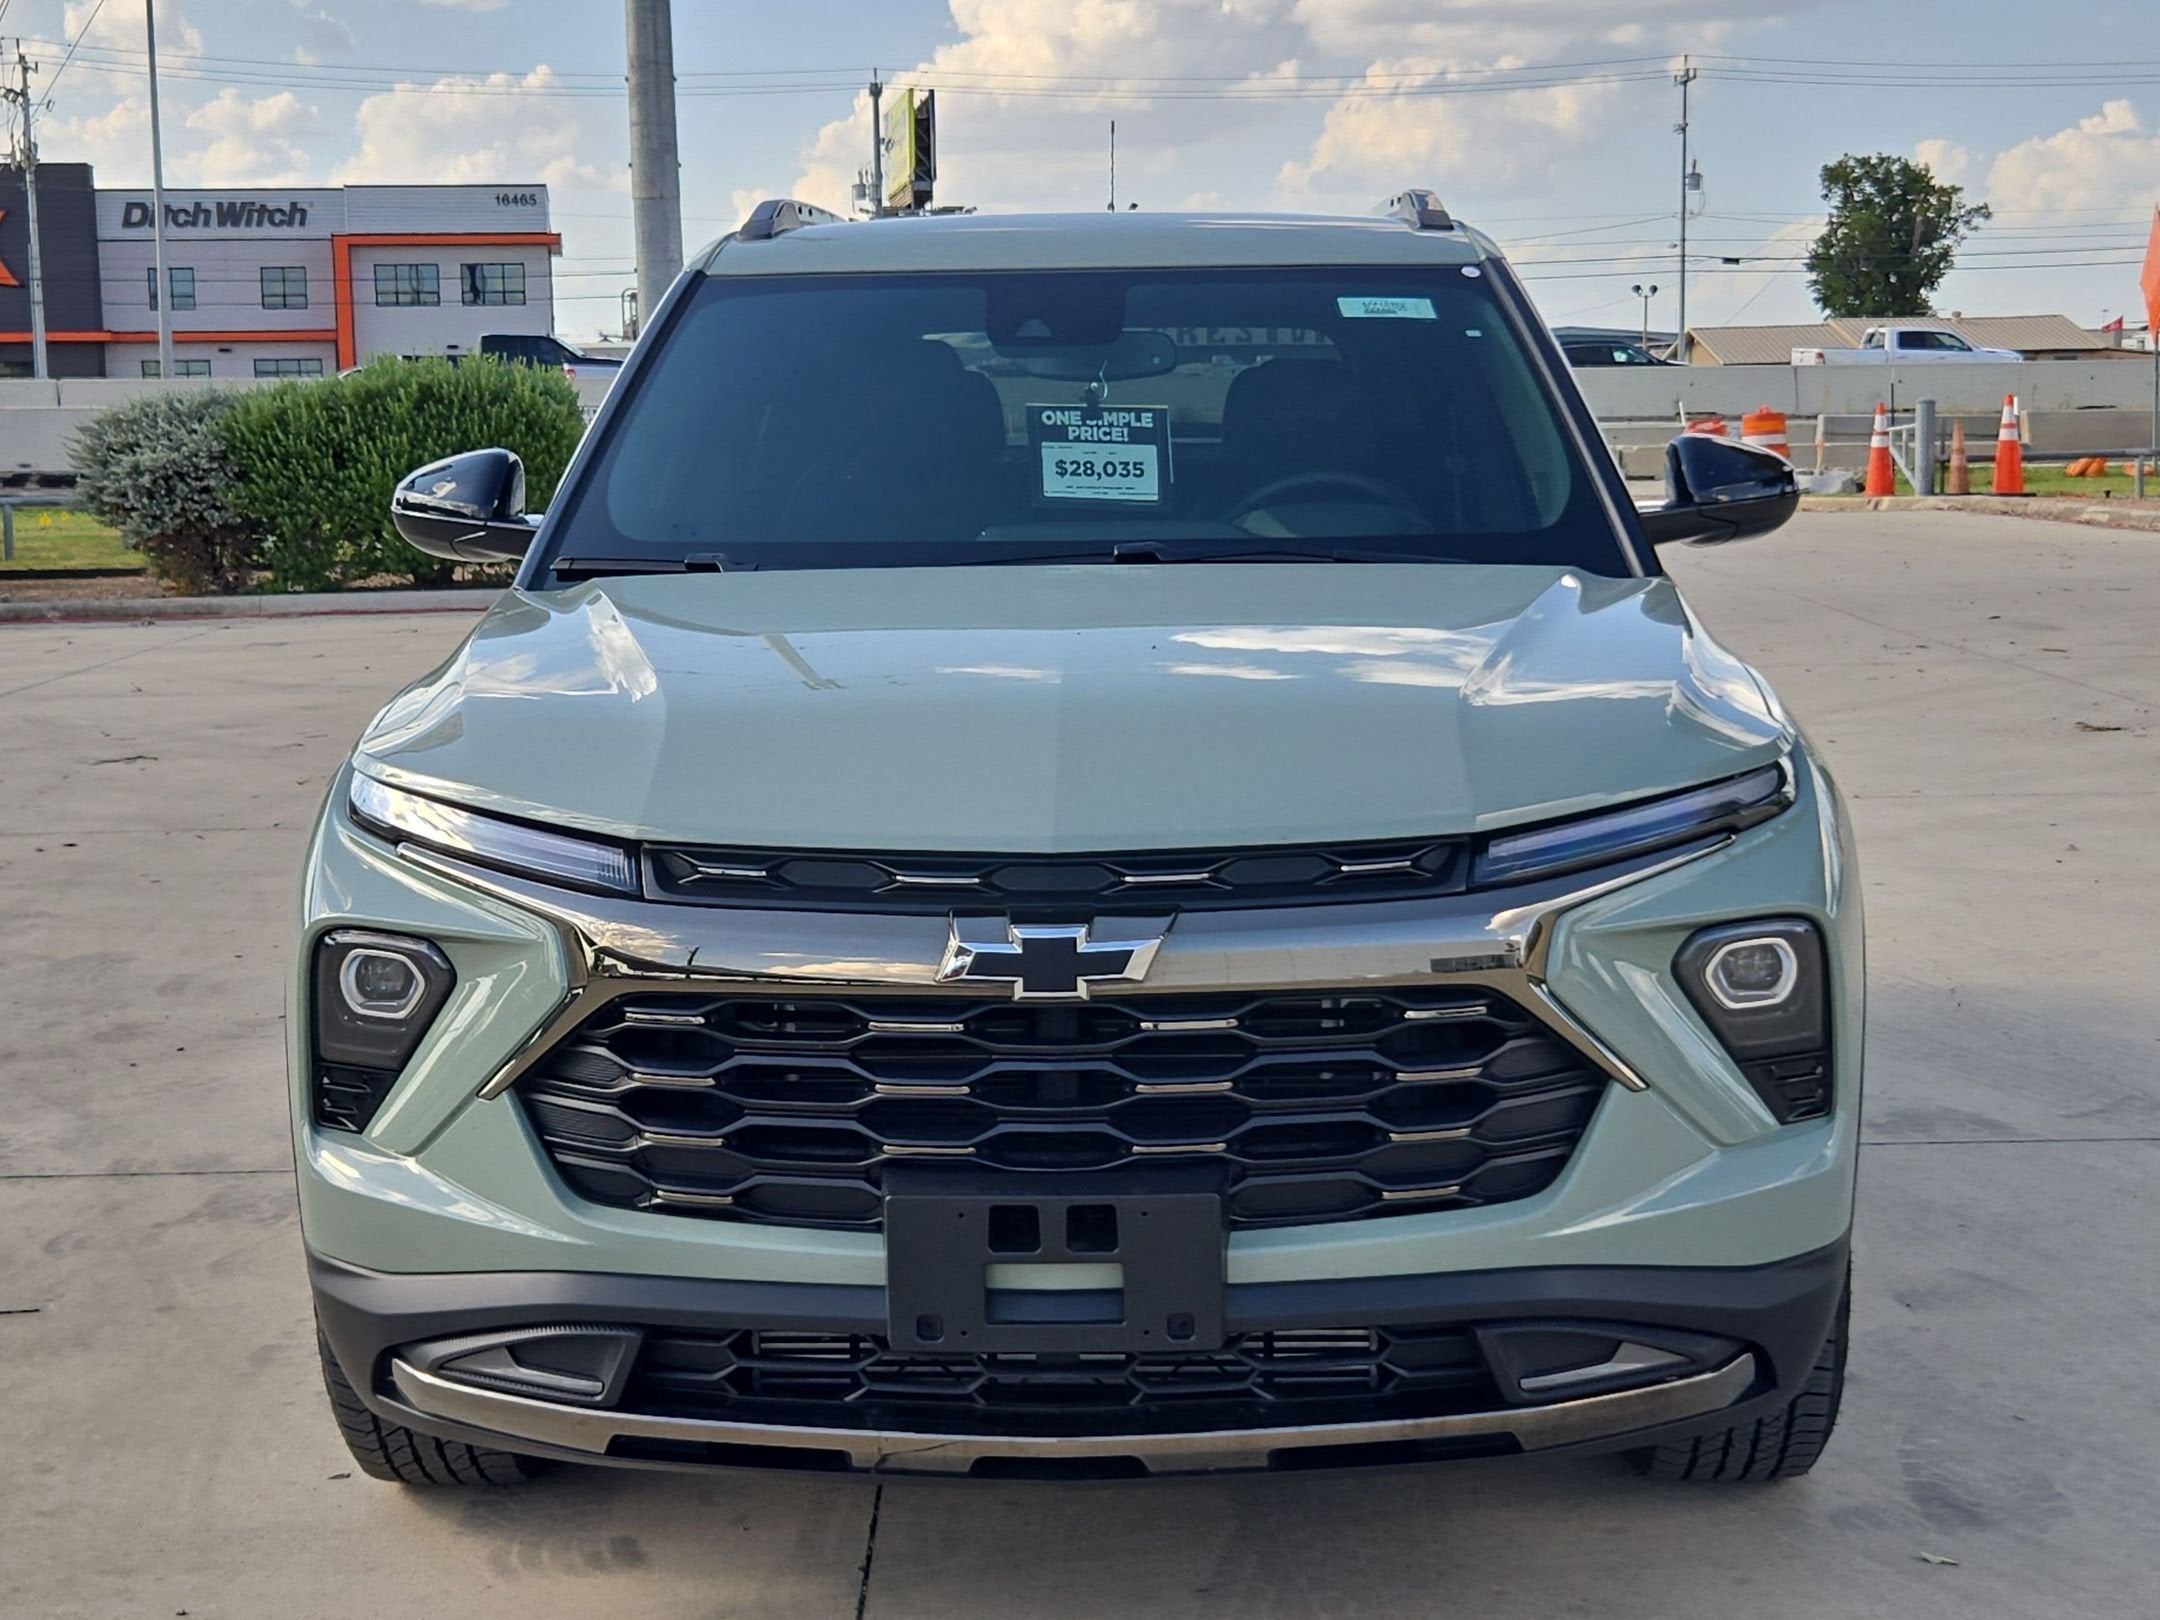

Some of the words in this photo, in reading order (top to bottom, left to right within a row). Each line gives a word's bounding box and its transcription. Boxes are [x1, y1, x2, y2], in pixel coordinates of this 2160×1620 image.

[216, 202, 308, 228] Witch
[1041, 410, 1082, 425] ONE
[1086, 411, 1154, 428] MPLE
[1067, 426, 1129, 442] PRICE!
[1055, 459, 1145, 480] $28,035
